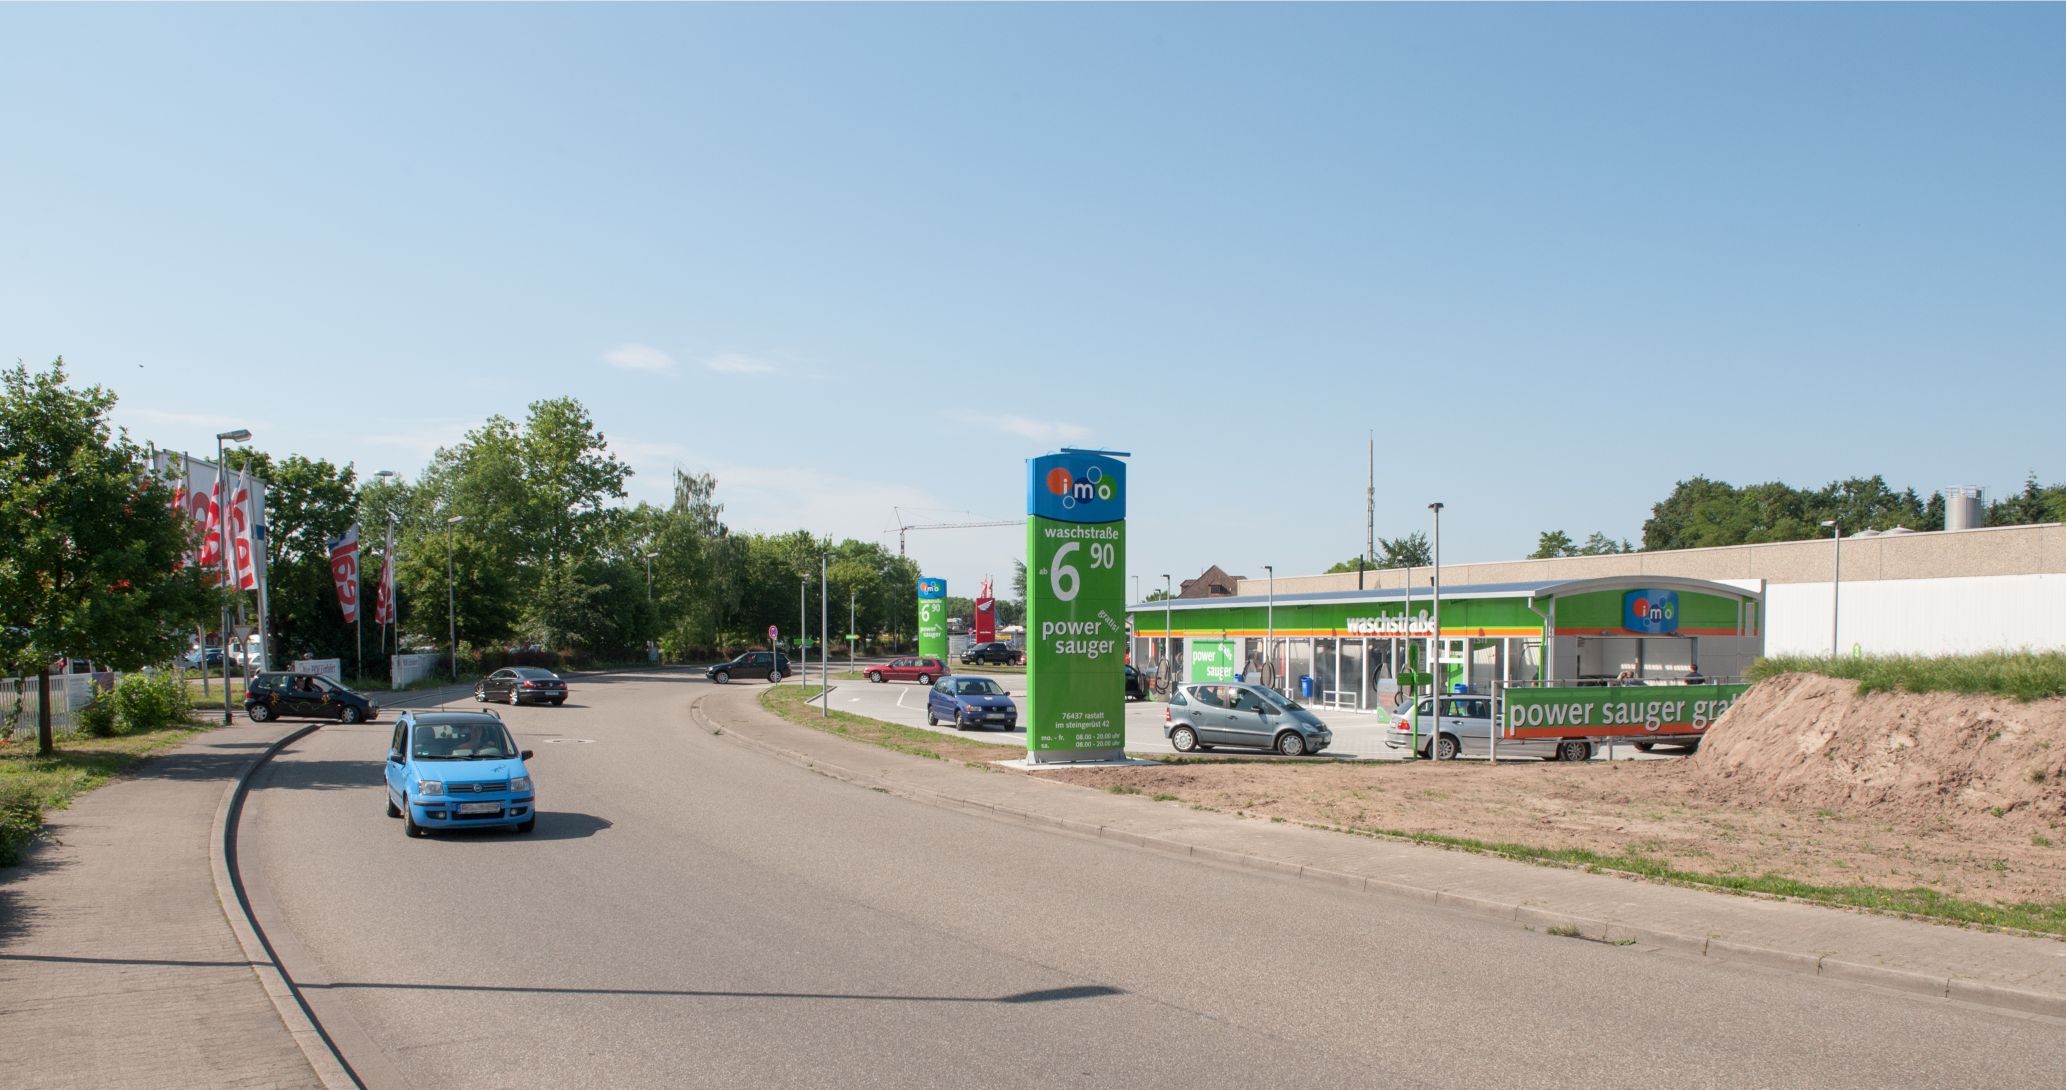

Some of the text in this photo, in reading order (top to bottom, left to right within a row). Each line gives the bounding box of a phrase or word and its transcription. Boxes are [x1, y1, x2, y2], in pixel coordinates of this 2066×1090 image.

[1063, 478, 1111, 500] imo
[1044, 525, 1119, 540] waschstraße
[1039, 541, 1115, 602] ab 6 90
[921, 603, 941, 622] 6 90
[1097, 609, 1120, 633] gratis!
[1347, 609, 1435, 634] waschstraße
[1642, 605, 1672, 619] imo
[1042, 620, 1102, 641] power
[1055, 639, 1116, 659] sauger
[1192, 651, 1216, 665] power
[1206, 666, 1232, 681] sauger
[1062, 711, 1104, 720] 76437 rastatt
[1509, 701, 1594, 737] power
[1602, 699, 1686, 732] sauger
[1055, 721, 1064, 729] im
[1065, 721, 1101, 730] steingerüst
